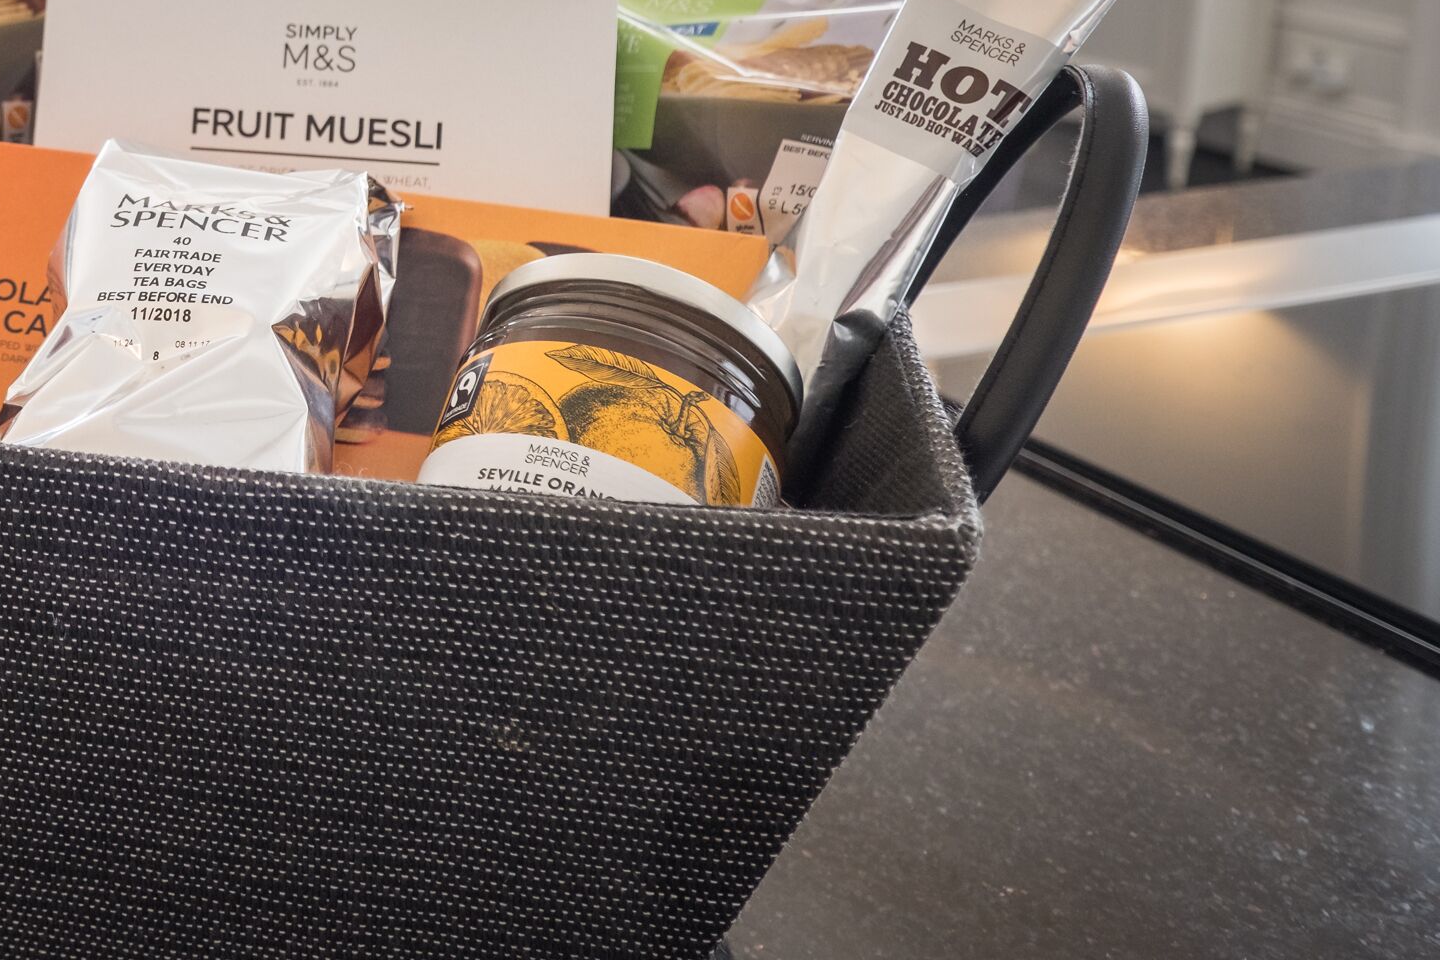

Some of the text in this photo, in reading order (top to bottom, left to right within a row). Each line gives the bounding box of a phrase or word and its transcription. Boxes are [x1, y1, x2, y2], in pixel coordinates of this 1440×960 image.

[286, 23, 358, 41] SIMPLY
[958, 19, 1026, 55] MARKS &
[283, 43, 356, 72] M&S
[951, 30, 1020, 67] SPENCER
[893, 41, 1033, 128] HOT
[874, 100, 903, 121] JUST
[902, 111, 925, 128] ADD
[925, 120, 953, 139] HOT
[882, 80, 1004, 150] CHOCOLATE
[191, 107, 443, 151] FRUIT MUESLI
[783, 145, 806, 154] BEST
[117, 193, 292, 228] MARKS &
[110, 210, 288, 242] SPENCER
[173, 236, 191, 246] 40
[134, 248, 222, 263] FAIRTRADE
[133, 262, 214, 276] EVERYDAY
[133, 277, 207, 289] TEA BAGS
[97, 291, 234, 305] BEST BEFORE END
[3, 310, 48, 338] CA
[131, 307, 192, 322] 11/2018
[153, 351, 159, 360] 8
[525, 454, 588, 477] SPENCER
[528, 444, 591, 467] MARKS &
[477, 468, 544, 486] SEVILLE
[548, 477, 616, 500] ORAN
